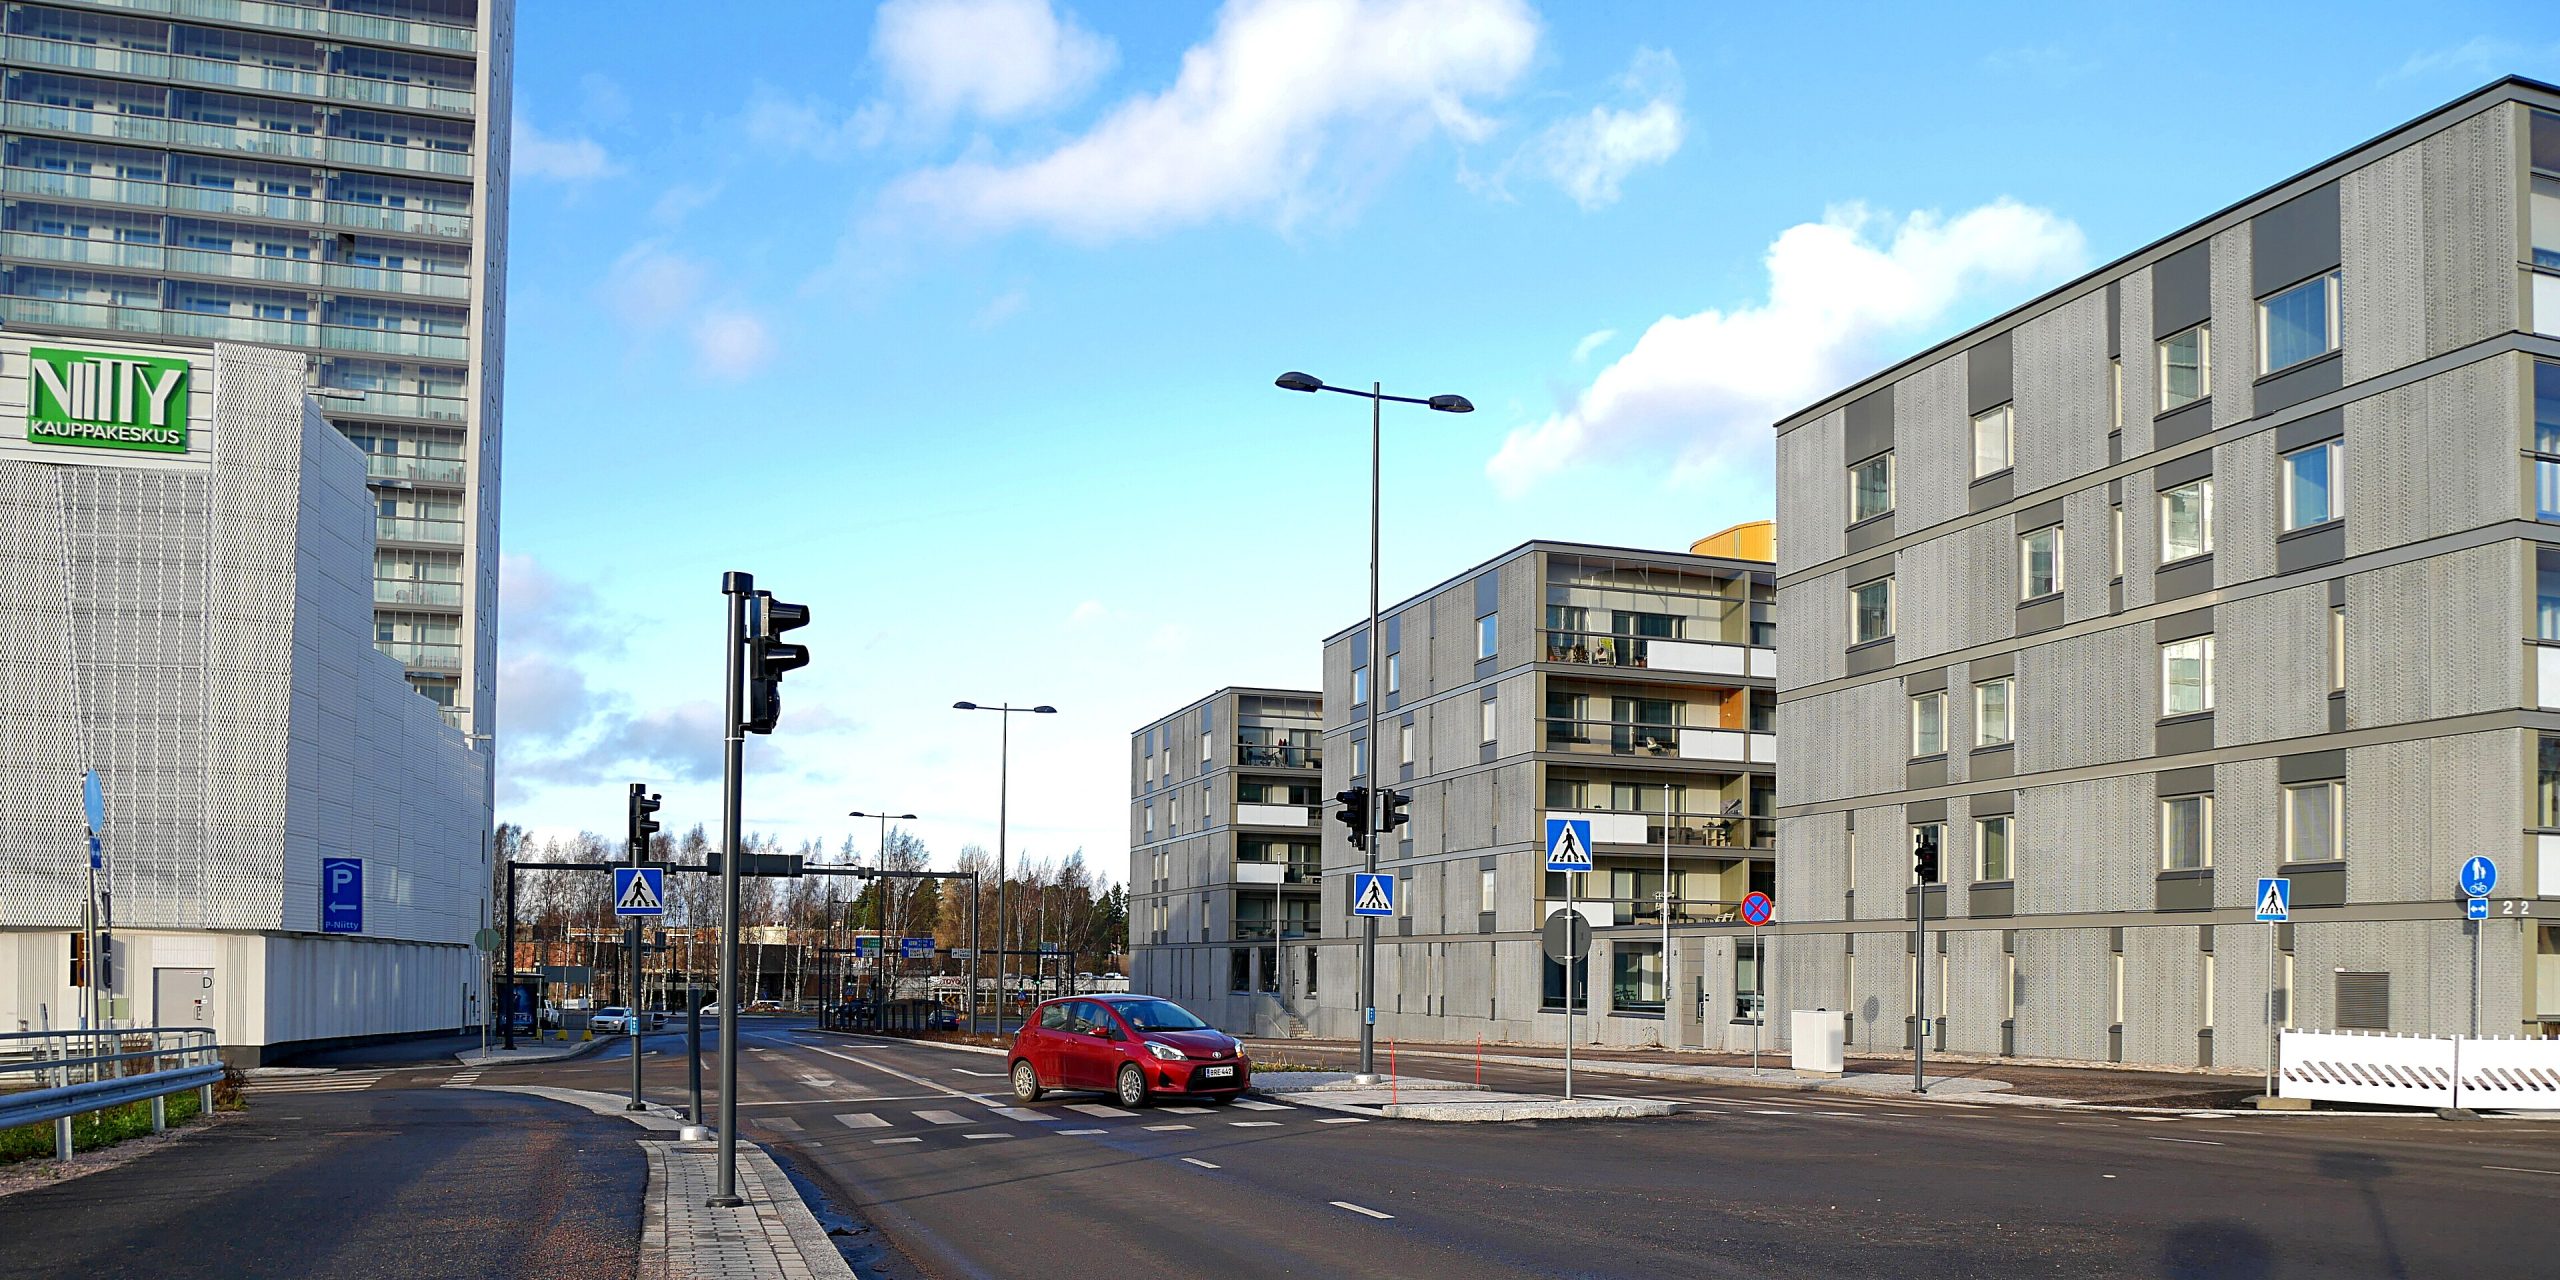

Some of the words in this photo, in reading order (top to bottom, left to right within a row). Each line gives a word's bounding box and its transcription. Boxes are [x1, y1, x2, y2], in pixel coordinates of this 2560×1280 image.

[31, 419, 180, 445] KAUPPAKESKUS
[332, 869, 353, 894] P
[2502, 900, 2513, 915] 2
[2520, 900, 2529, 915] 2
[325, 920, 359, 931] P-Niitty
[202, 976, 213, 989] D
